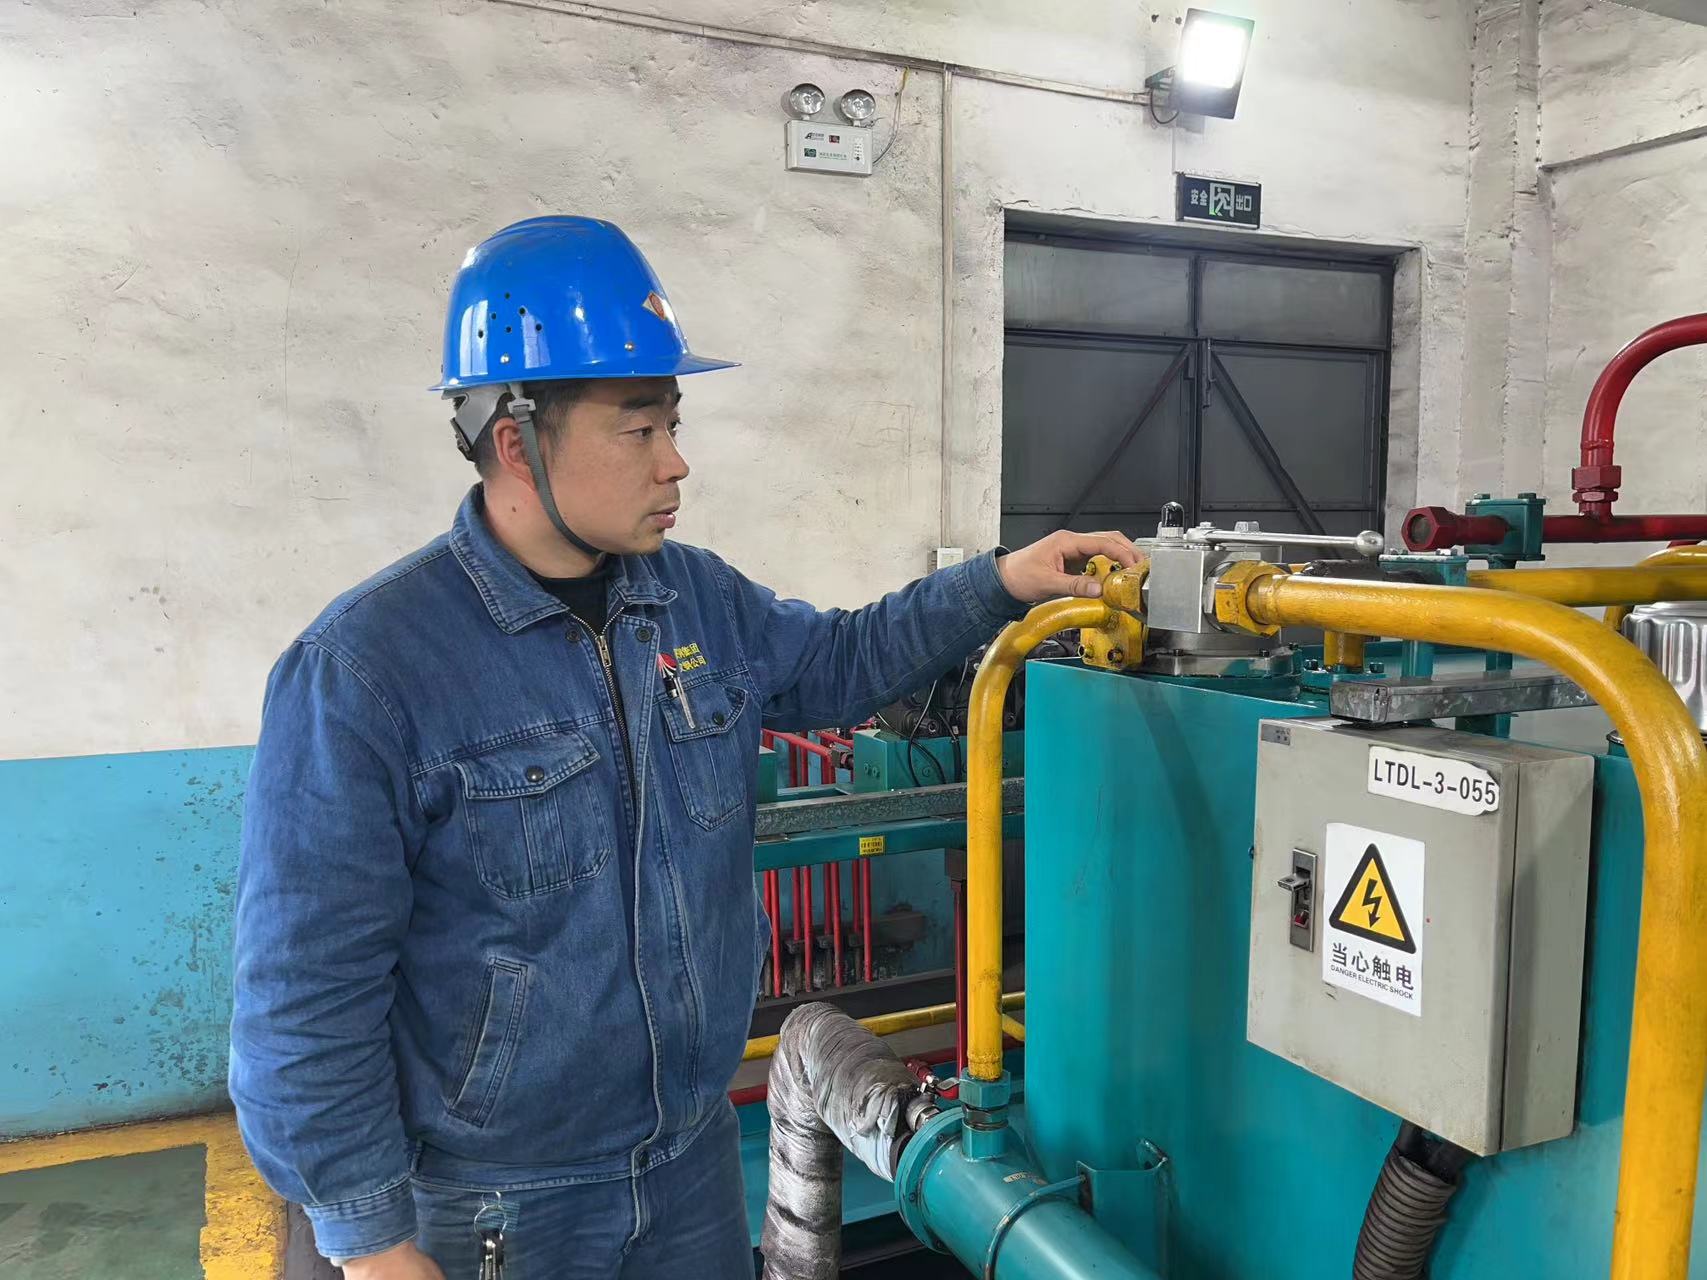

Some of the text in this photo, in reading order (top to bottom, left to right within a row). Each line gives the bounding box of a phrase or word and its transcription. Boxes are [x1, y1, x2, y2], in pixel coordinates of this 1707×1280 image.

[1190, 188, 1252, 212] 安全 出口
[1374, 758, 1496, 805] LTDL-3-055
[1330, 964, 1414, 1000] DANGER ELECTRIC SHOCK
[1332, 942, 1414, 991] 当心触电
